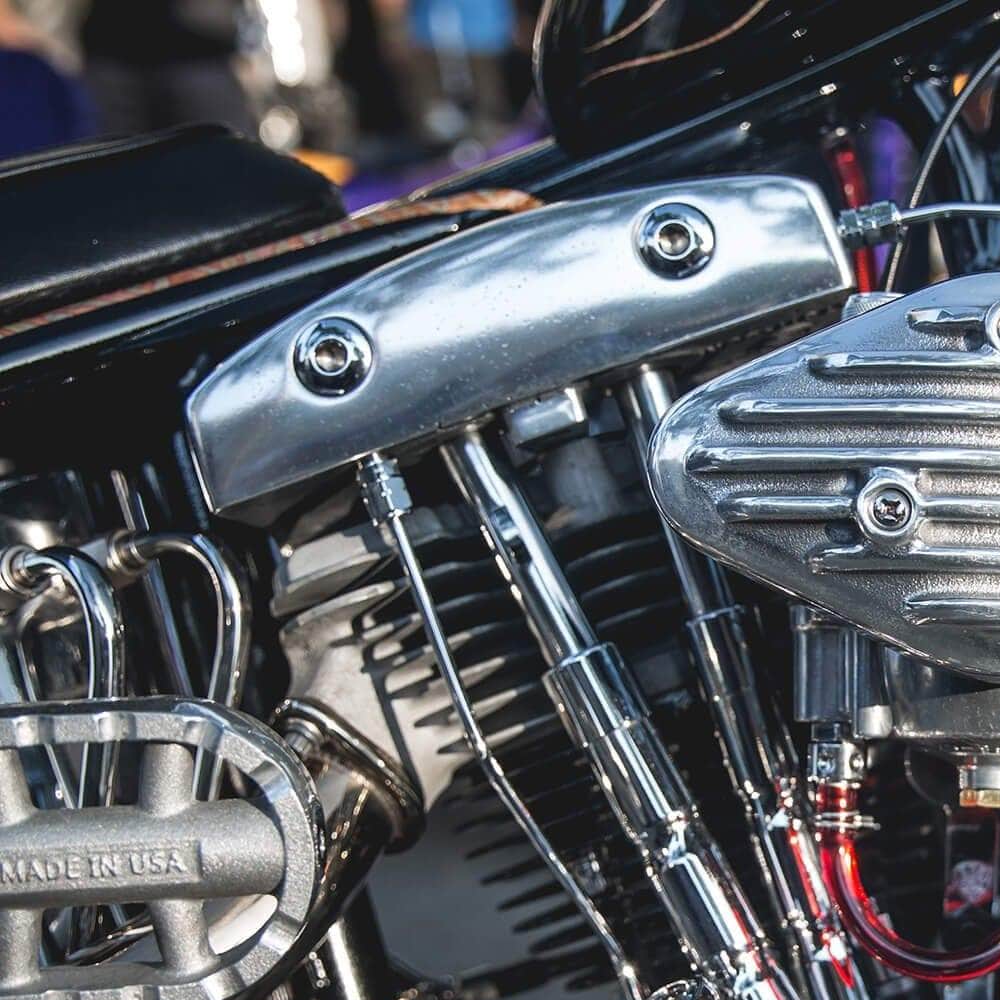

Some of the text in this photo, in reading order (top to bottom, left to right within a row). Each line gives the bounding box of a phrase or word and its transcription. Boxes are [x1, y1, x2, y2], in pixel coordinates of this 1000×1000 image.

[0, 849, 188, 883] MADE IN USA
